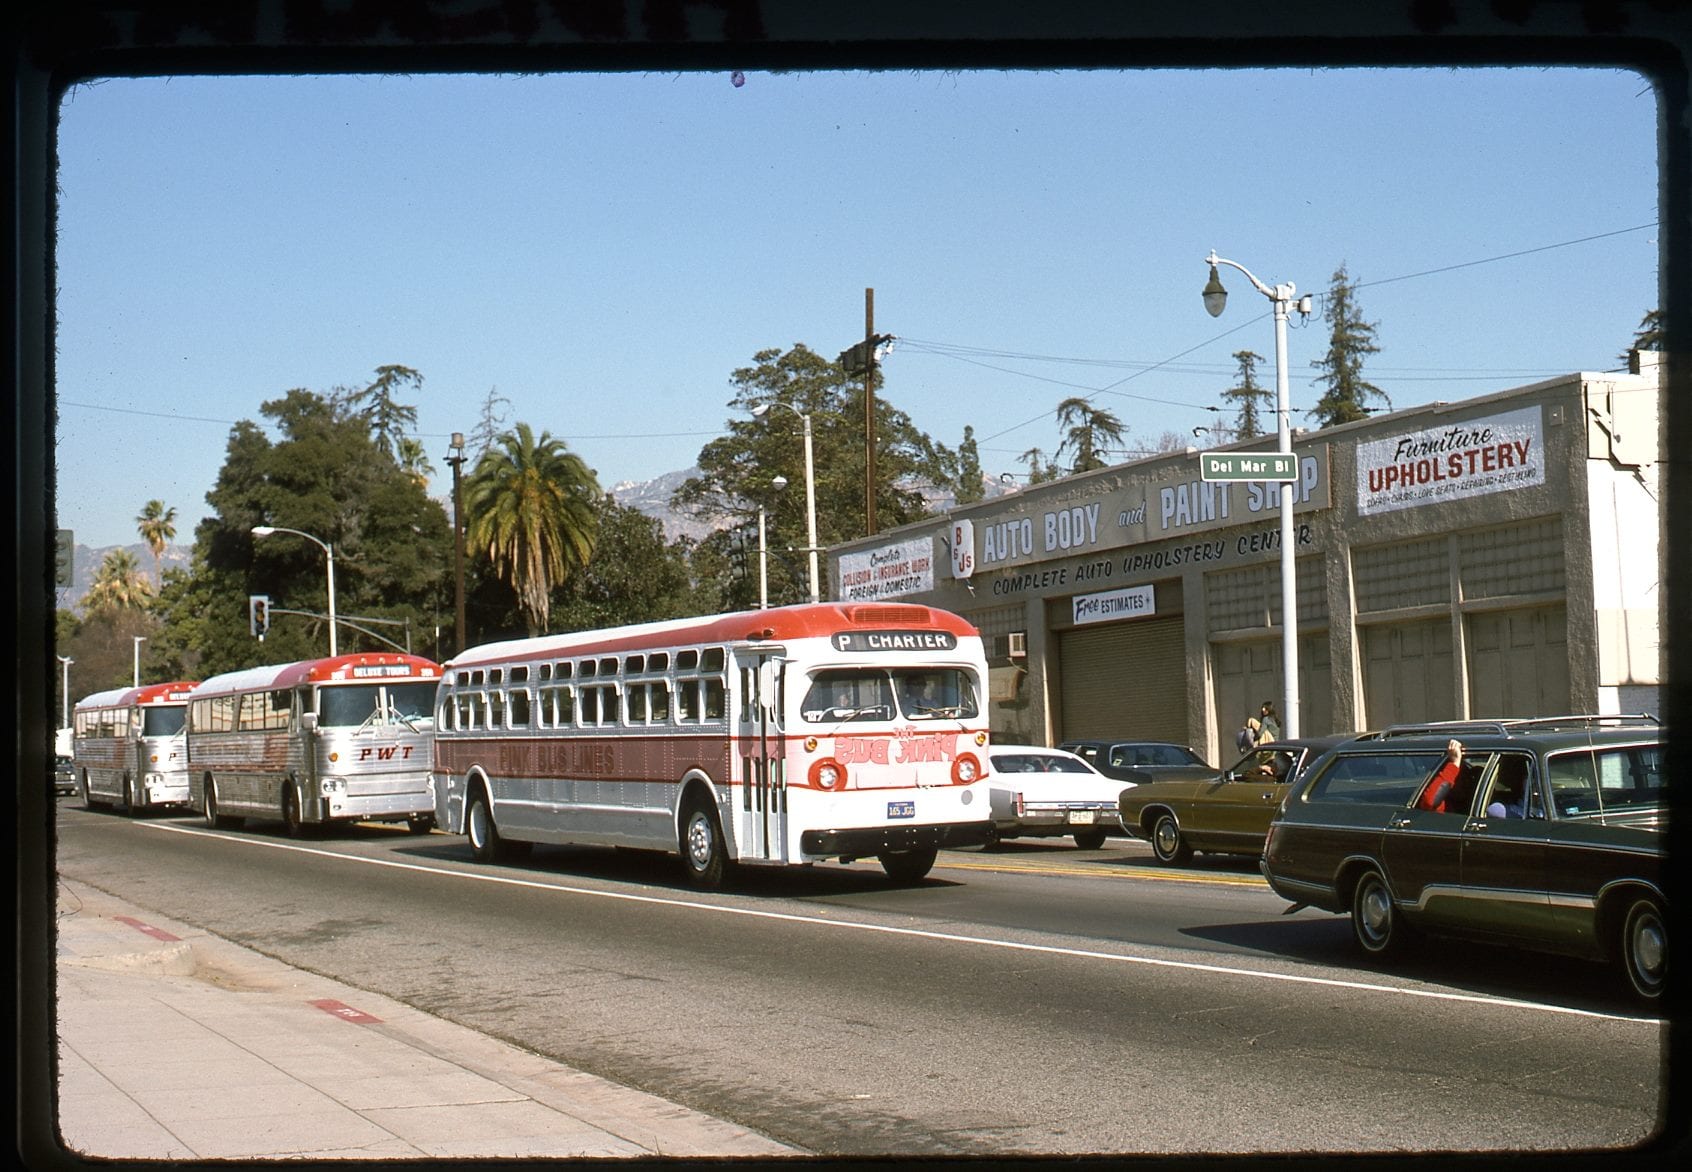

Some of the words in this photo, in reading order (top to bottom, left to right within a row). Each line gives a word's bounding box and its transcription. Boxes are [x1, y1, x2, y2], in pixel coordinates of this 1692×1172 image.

[1394, 427, 1493, 462] Furniture
[1210, 459, 1232, 473] Del
[1240, 459, 1267, 473] Mar
[1274, 459, 1289, 473] Bl
[1368, 438, 1531, 494] UPHOLSTERY
[1418, 487, 1433, 499] LOVE
[983, 517, 1033, 564] AUTO
[1044, 502, 1101, 552] BODY
[1118, 500, 1147, 528] and
[1160, 480, 1232, 530] PAINT
[1247, 455, 1319, 513] SHP
[955, 526, 962, 545] B
[993, 568, 1068, 596] COMPLETE
[1075, 560, 1113, 583] AUTO
[1123, 540, 1226, 574] UPHOLSTERY
[1237, 524, 1313, 556] CENTR
[849, 583, 880, 600] FOREIGN
[885, 575, 921, 594] DOMESTIC
[1075, 598, 1100, 622] Free
[1101, 593, 1144, 614] ESTIMATES
[838, 635, 851, 651] P
[868, 634, 948, 649] CHARTER
[500, 746, 531, 772] PINK
[538, 745, 568, 773] BUS
[572, 744, 615, 775] LINES
